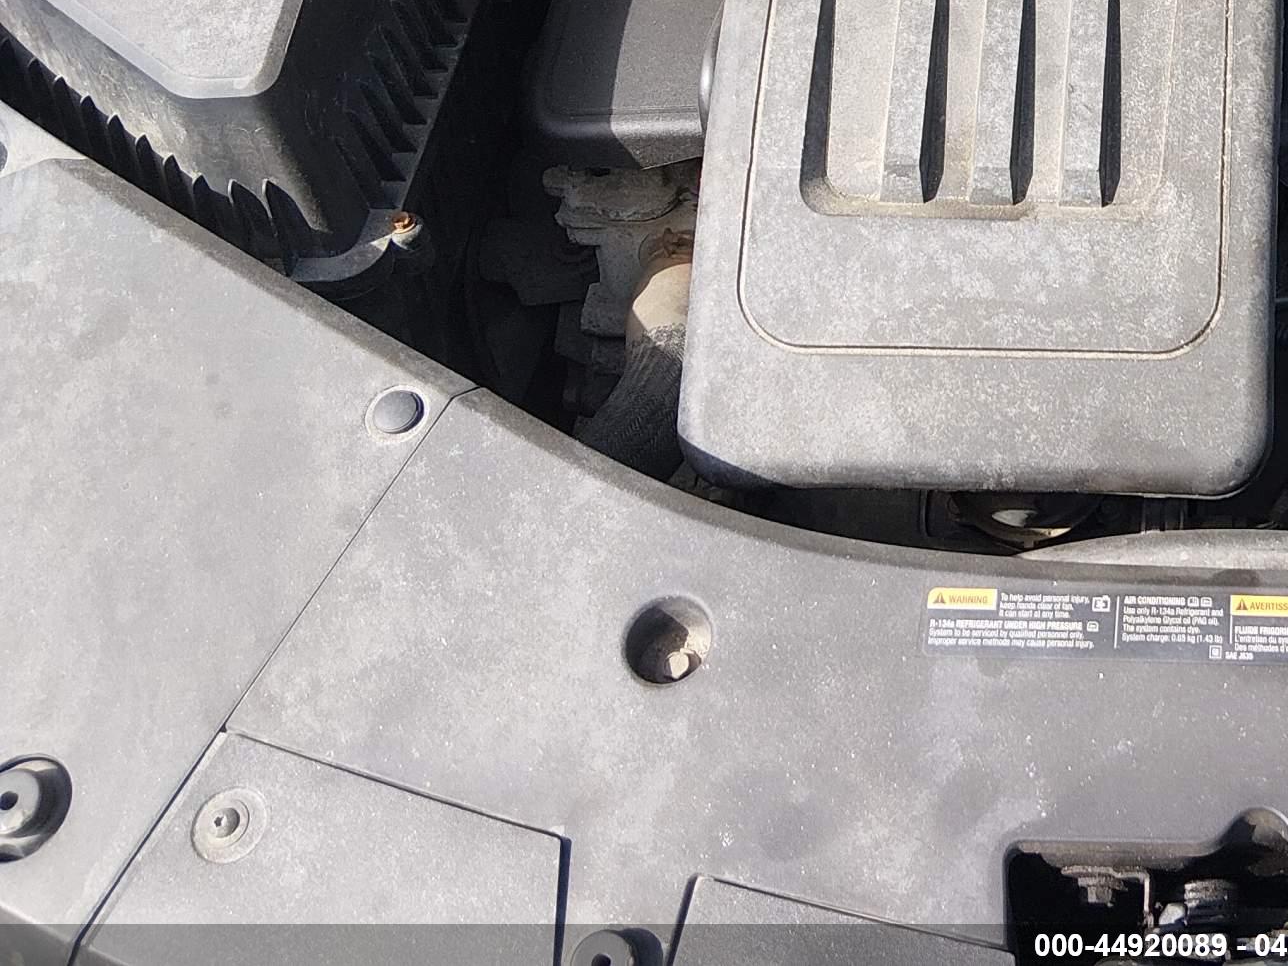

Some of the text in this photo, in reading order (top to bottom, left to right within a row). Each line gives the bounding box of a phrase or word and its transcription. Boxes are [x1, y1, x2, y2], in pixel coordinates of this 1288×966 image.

[949, 595, 988, 603] WARNING
[1124, 595, 1186, 606] AIR CONDITIONING
